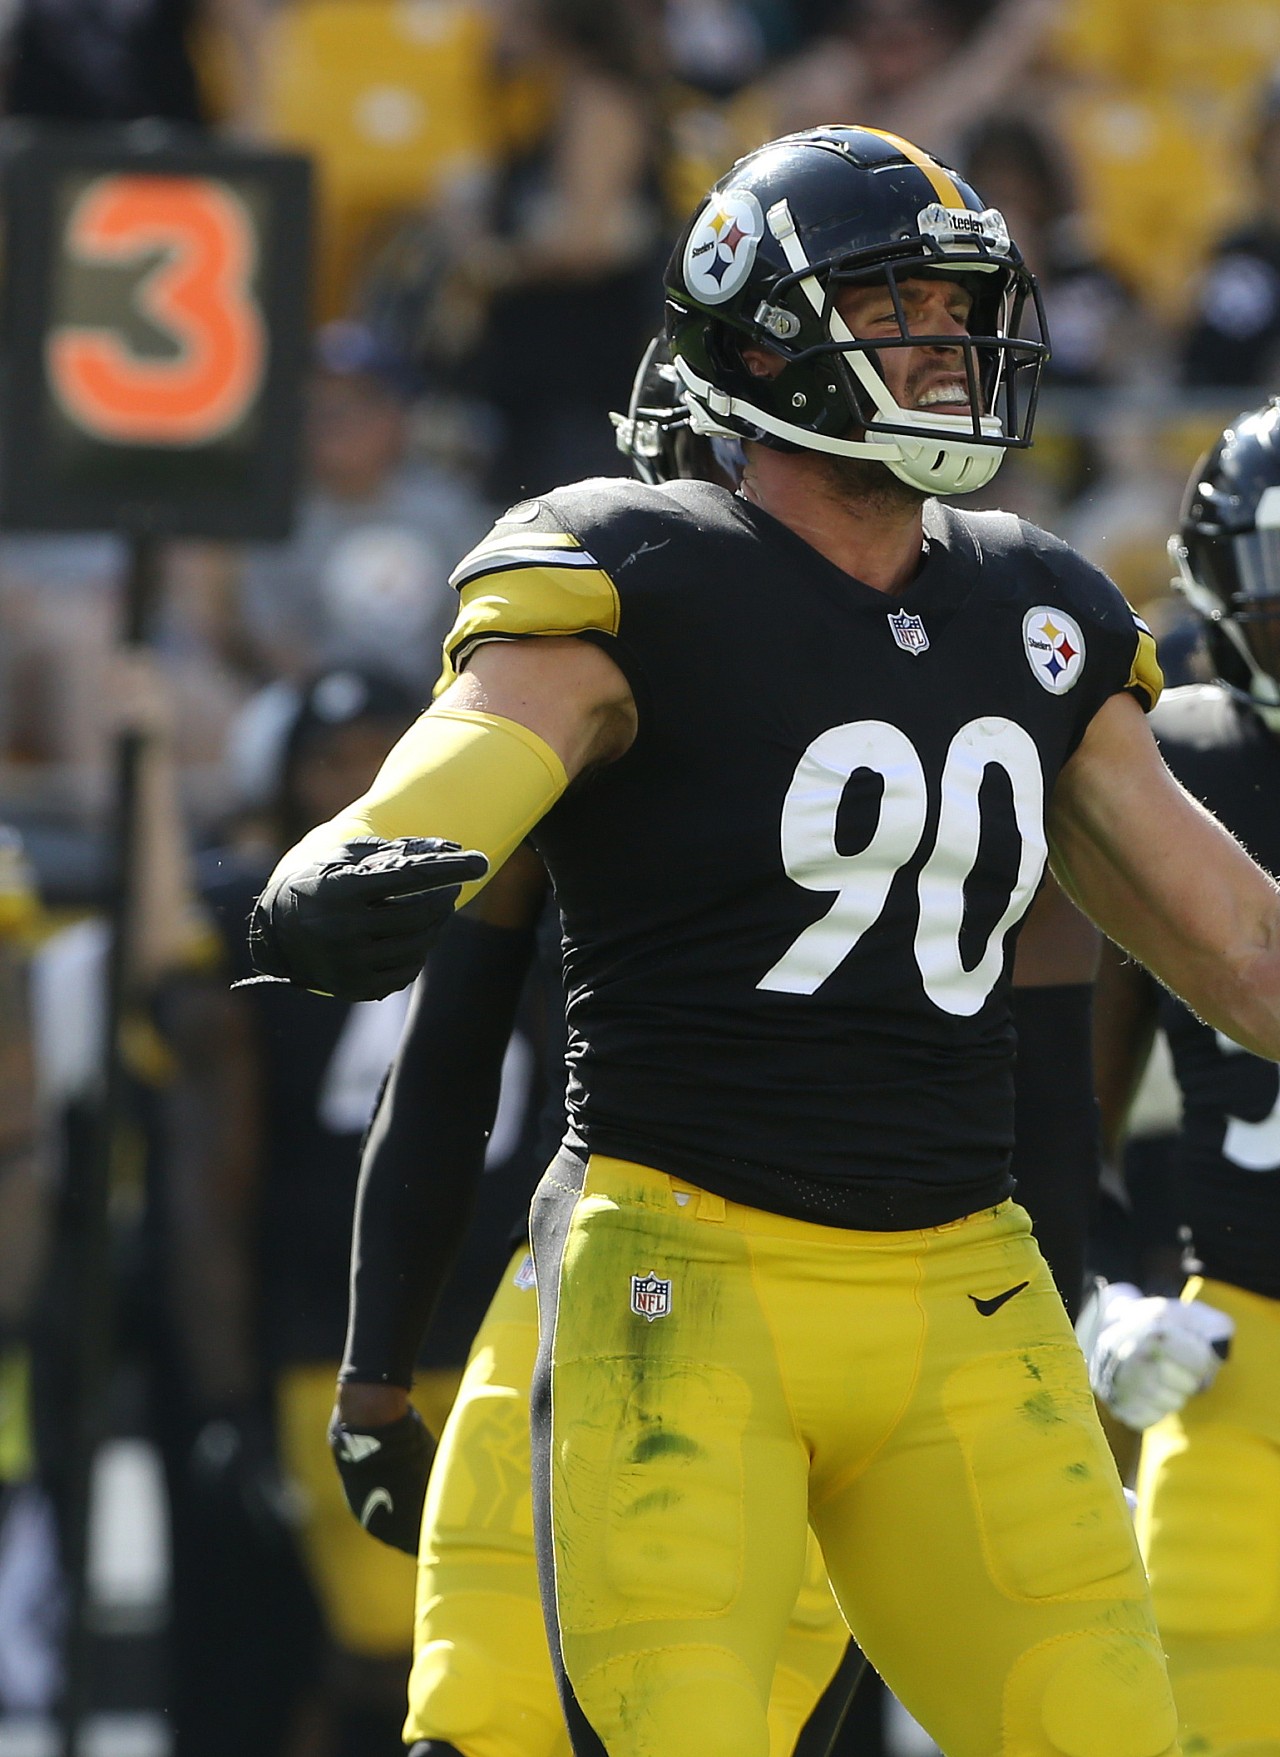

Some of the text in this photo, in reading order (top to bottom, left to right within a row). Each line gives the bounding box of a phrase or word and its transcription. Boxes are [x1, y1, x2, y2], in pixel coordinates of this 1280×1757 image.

[47, 172, 267, 447] 3
[899, 629, 924, 646] NFL
[755, 716, 1048, 1016] 90
[637, 1293, 664, 1312] NFL
